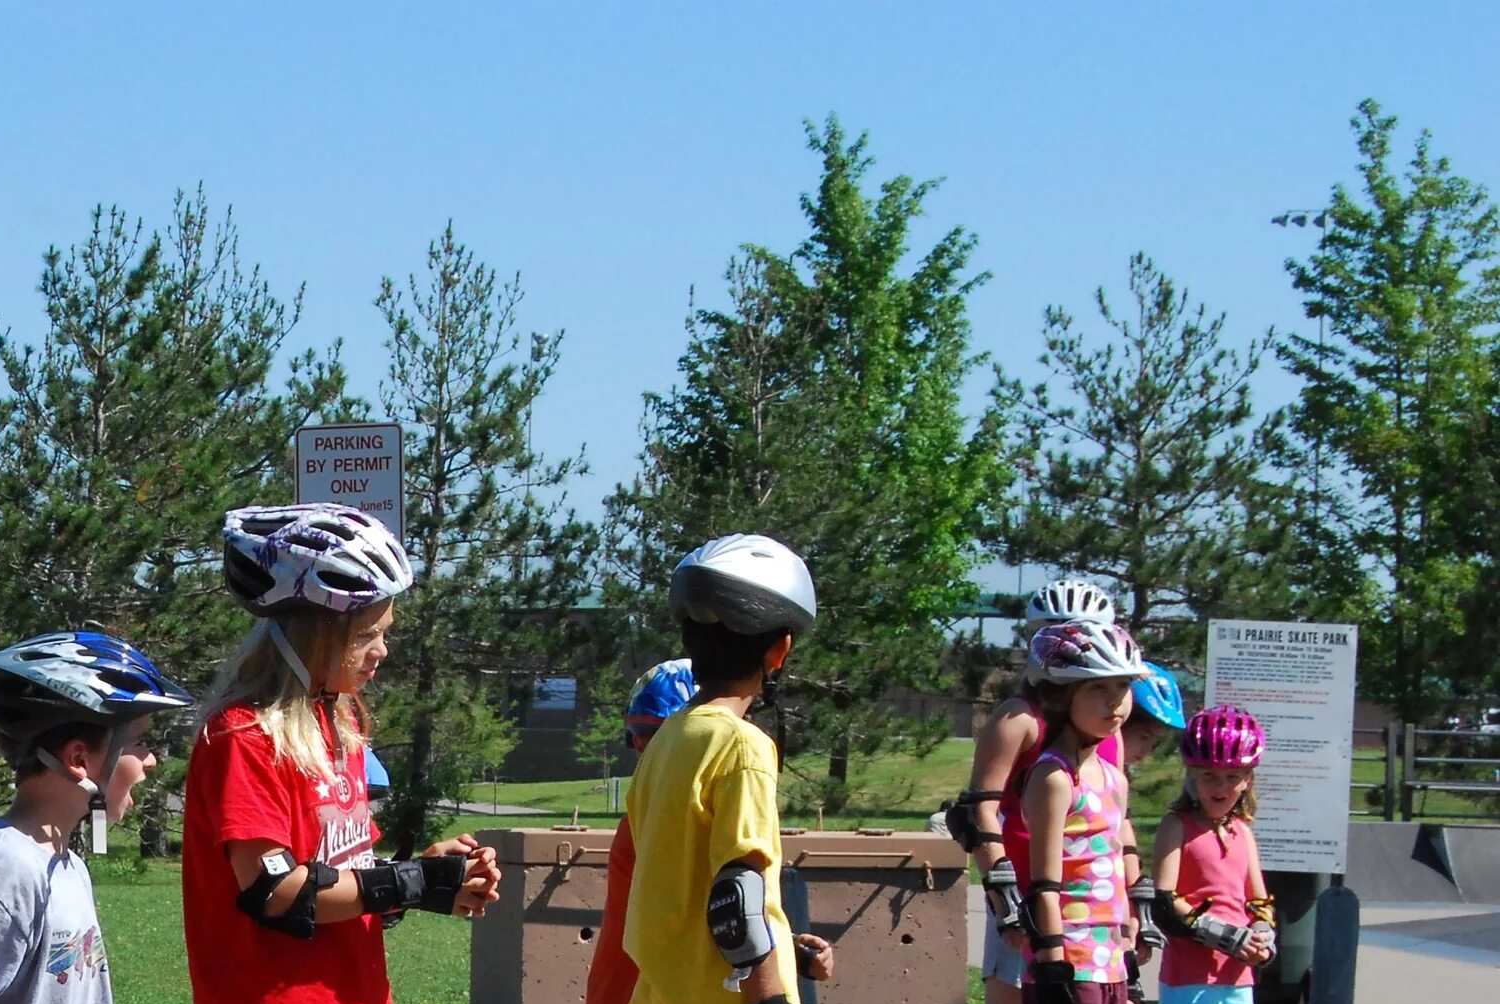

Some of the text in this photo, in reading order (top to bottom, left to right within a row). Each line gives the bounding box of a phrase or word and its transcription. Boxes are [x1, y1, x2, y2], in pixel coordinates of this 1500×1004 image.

[314, 435, 384, 451] PARKING
[305, 456, 393, 474] BY PERMIT
[330, 478, 370, 494] ONLY
[1245, 629, 1284, 643] PRAIRIE
[1287, 630, 1319, 645] SKATE
[1322, 632, 1349, 646] PARK
